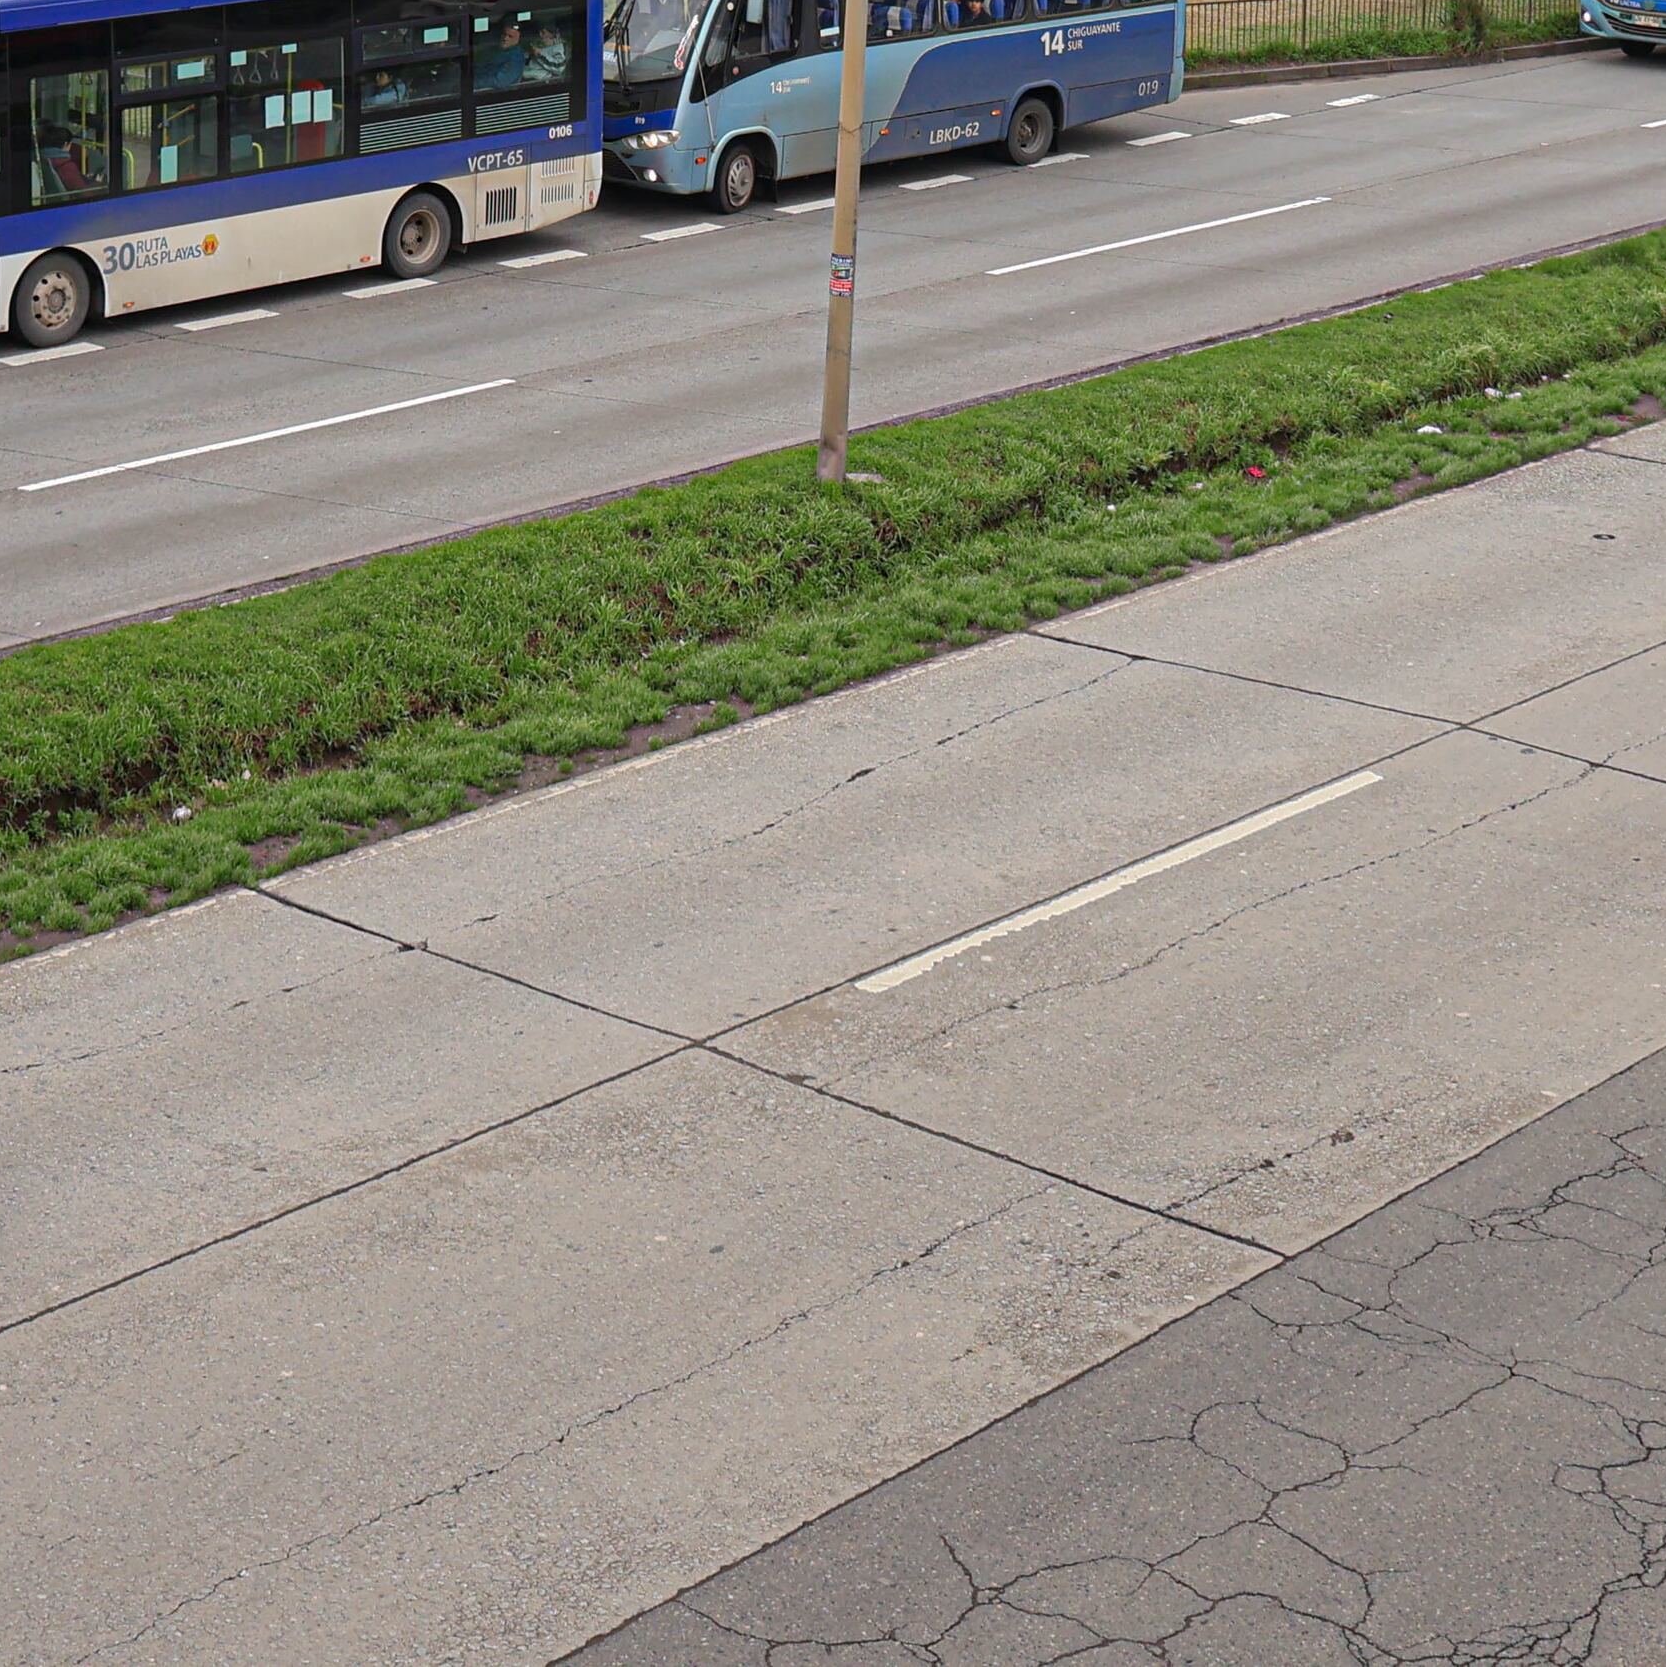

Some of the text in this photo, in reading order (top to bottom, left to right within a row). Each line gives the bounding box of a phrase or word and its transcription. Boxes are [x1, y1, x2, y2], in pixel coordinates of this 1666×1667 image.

[1040, 21, 1121, 56] 14 CHIGUAYANTE
[1067, 39, 1084, 51] SUR
[770, 81, 783, 94] 14
[1138, 79, 1159, 96] 019
[548, 124, 573, 140] 0106
[929, 121, 980, 145] LBKD-62
[467, 149, 524, 173] VCPT-65
[102, 236, 169, 275] 30 RUTA
[136, 244, 202, 269] LAS PLAYAS
